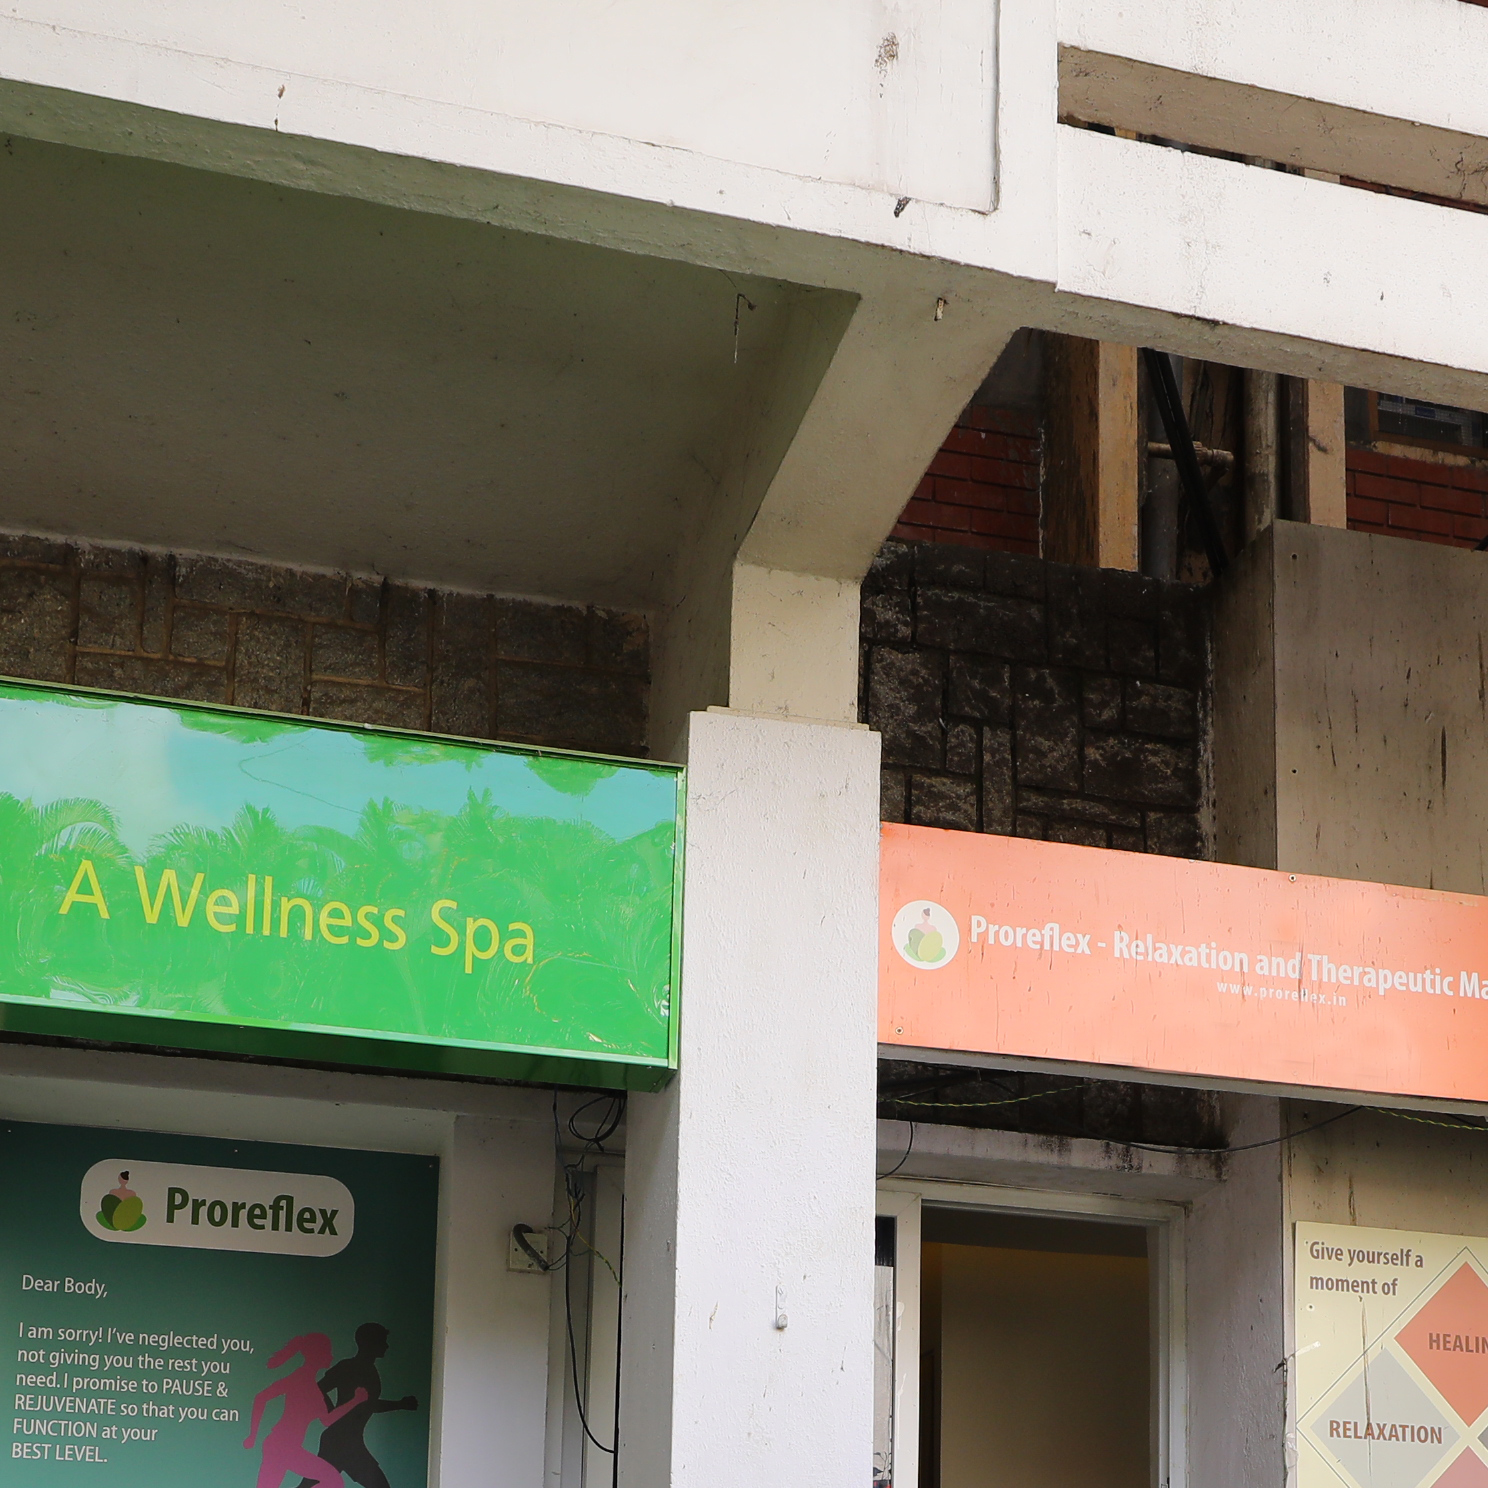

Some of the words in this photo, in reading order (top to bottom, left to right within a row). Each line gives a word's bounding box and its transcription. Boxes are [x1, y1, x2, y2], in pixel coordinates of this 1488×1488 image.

[59, 859, 110, 920] A
[134, 865, 408, 950] Wellness
[430, 899, 535, 974] Spa
[970, 915, 1091, 955] Proreflex
[1113, 931, 1249, 972] Relaxation
[1255, 949, 1302, 980] and
[1308, 953, 1454, 997] Therapeutic
[1216, 982, 1347, 1006] www.proreflex.in
[166, 1186, 339, 1236] Proreflex
[1309, 1241, 1343, 1262] Give
[1348, 1244, 1411, 1268] yourself
[1415, 1253, 1423, 1268] a
[22, 1275, 60, 1292] Dear
[64, 1277, 108, 1299] Body,
[1309, 1275, 1378, 1295] moment
[1381, 1277, 1398, 1296] of
[19, 1322, 23, 1337] I
[27, 1326, 53, 1340] am
[58, 1327, 102, 1346] sorry!
[139, 1331, 217, 1350] neglected
[221, 1338, 254, 1354] you,
[18, 1349, 45, 1363] not
[49, 1349, 99, 1371] giving
[104, 1356, 133, 1371] you
[138, 1354, 163, 1369] the
[168, 1357, 197, 1372] rest
[201, 1361, 230, 1377] you
[16, 1372, 60, 1388] need.
[64, 1373, 68, 1388] I
[73, 1376, 137, 1392] promise
[142, 1379, 158, 1393] to
[163, 1378, 212, 1396] PAUSE
[216, 1382, 228, 1397] &
[14, 1394, 116, 1415] REJUVENATE
[120, 1403, 137, 1416] so
[142, 1401, 174, 1418] that
[178, 1407, 207, 1422] you
[212, 1408, 239, 1422] can
[13, 1419, 97, 1438] FUNCTION
[101, 1425, 117, 1439] at
[121, 1427, 158, 1443] your
[1329, 1419, 1443, 1445] RELAXATION
[12, 1443, 51, 1460] BEST
[55, 1445, 107, 1462] LEVEL.
